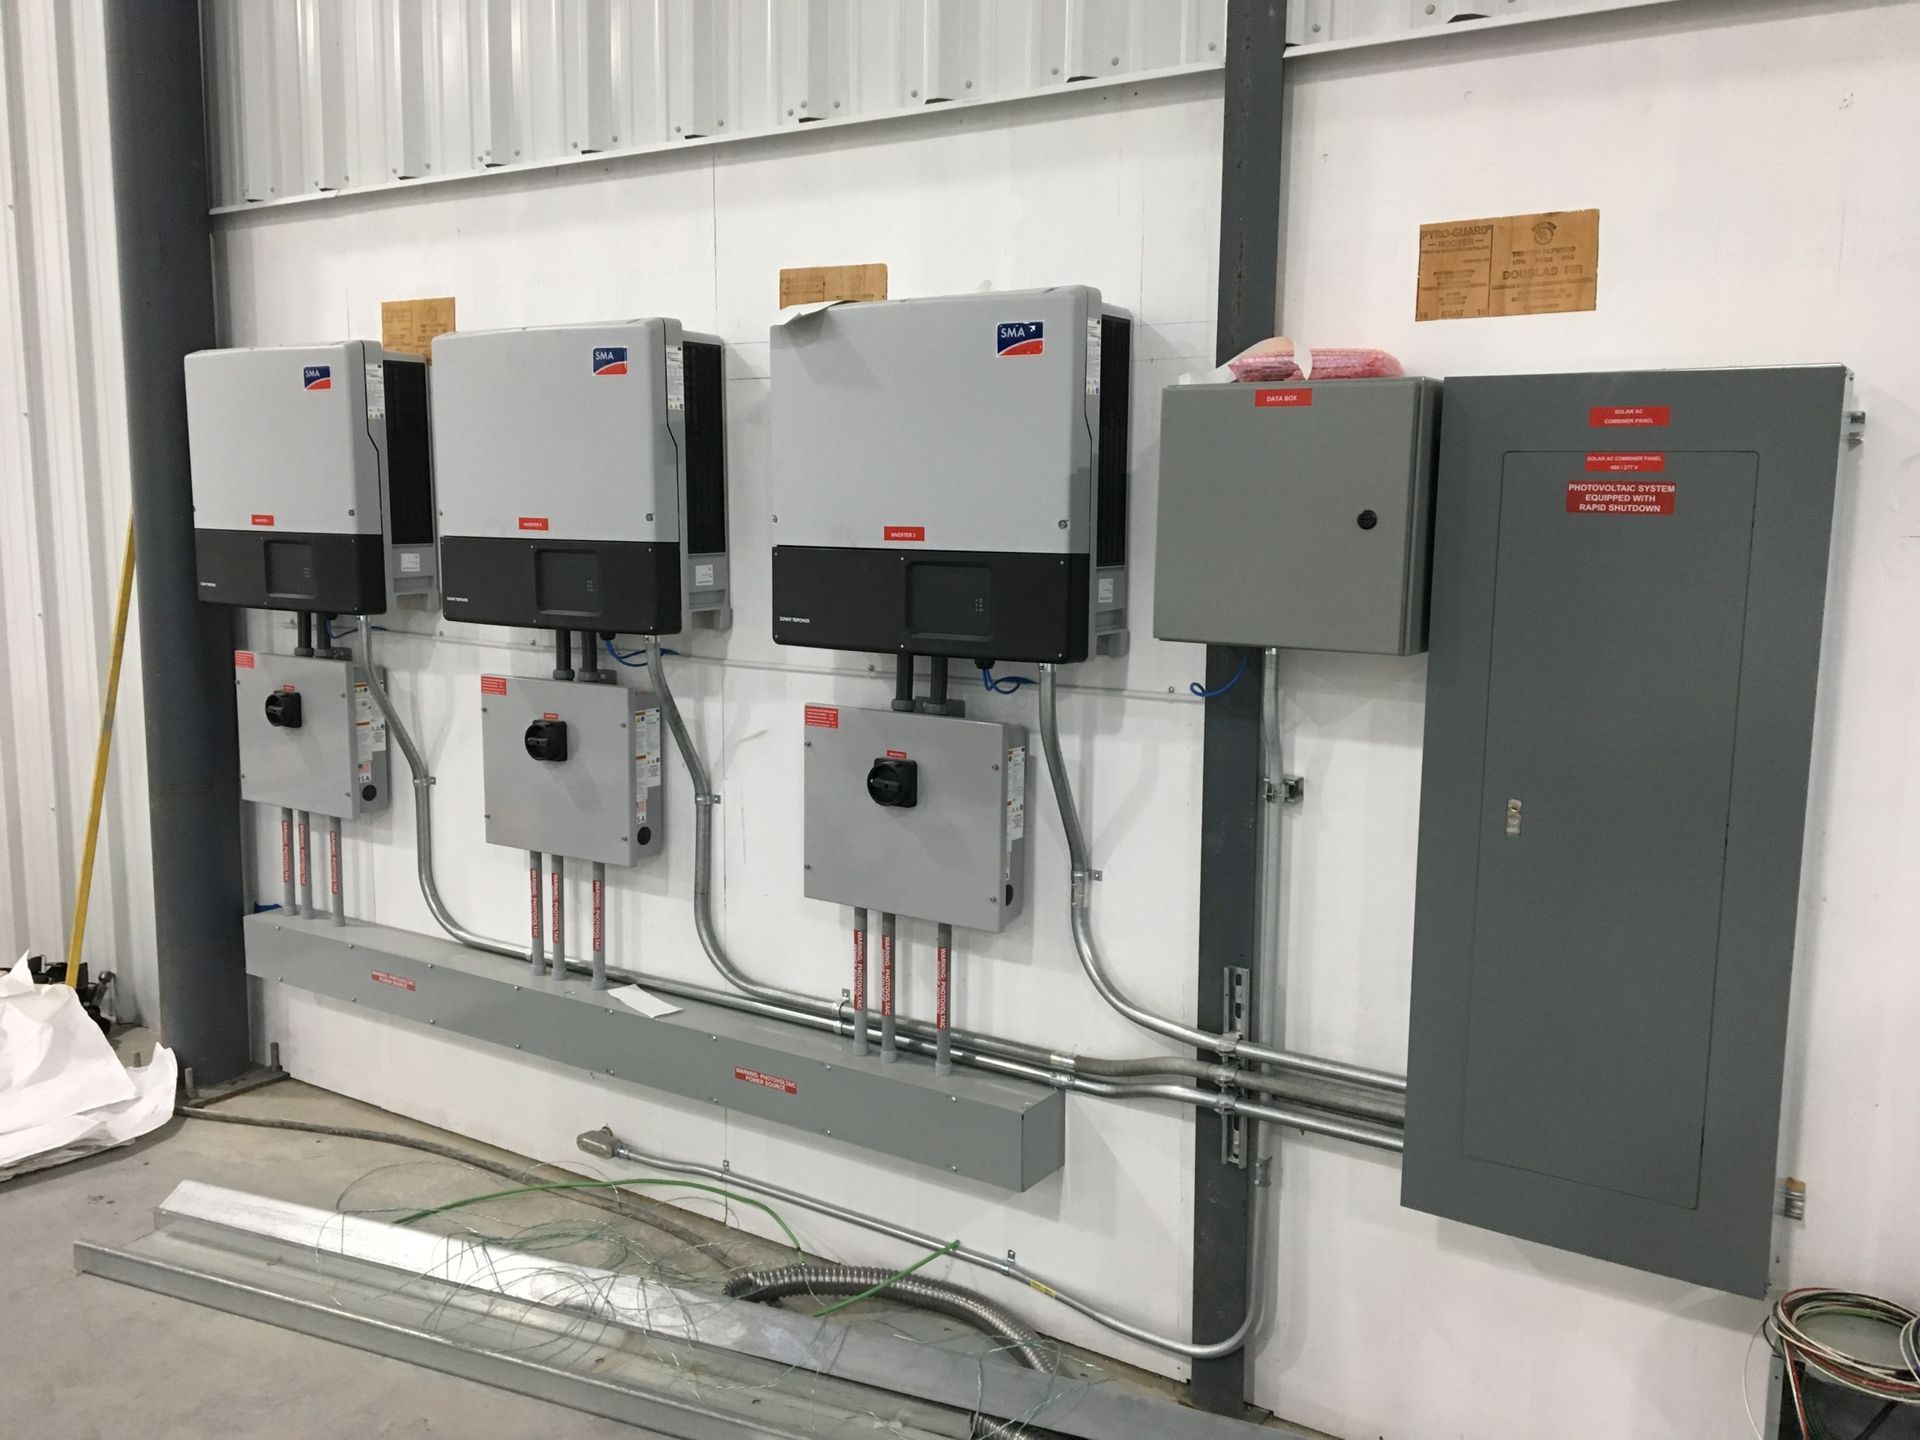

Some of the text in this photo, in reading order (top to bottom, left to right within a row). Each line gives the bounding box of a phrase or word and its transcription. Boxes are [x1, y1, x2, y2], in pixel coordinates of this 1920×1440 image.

[1502, 266, 1559, 280] DOUGLAS
[1000, 326, 1026, 339] SMA
[595, 351, 615, 361] SMA
[304, 369, 321, 378] SMA
[1568, 483, 1676, 493] PHOTOVOLTAIC SYSTEM
[1584, 493, 1656, 503] EQUIPPED WITH
[1579, 503, 1661, 513] RAPID SHUTDOWN
